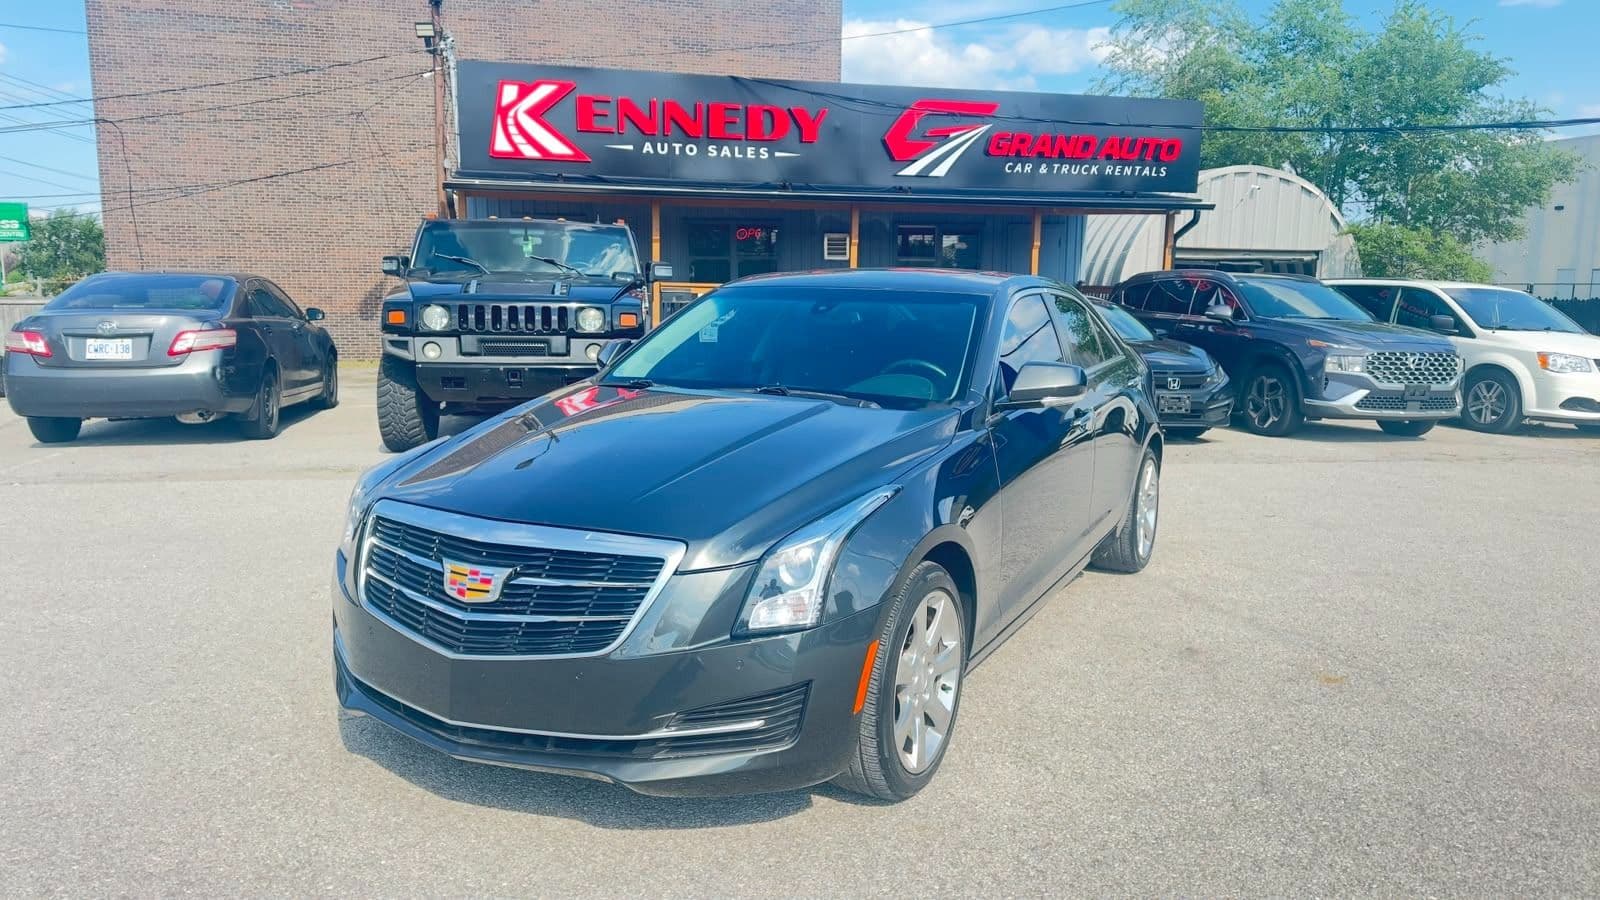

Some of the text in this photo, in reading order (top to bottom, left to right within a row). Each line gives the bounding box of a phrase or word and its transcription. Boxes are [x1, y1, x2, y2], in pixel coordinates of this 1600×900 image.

[489, 79, 829, 163] KENNEDY
[642, 142, 769, 159] AUTO SALES
[987, 131, 1184, 163] GRAND AUTO
[1005, 162, 1168, 178] CAR & TRUCK RENTALS
